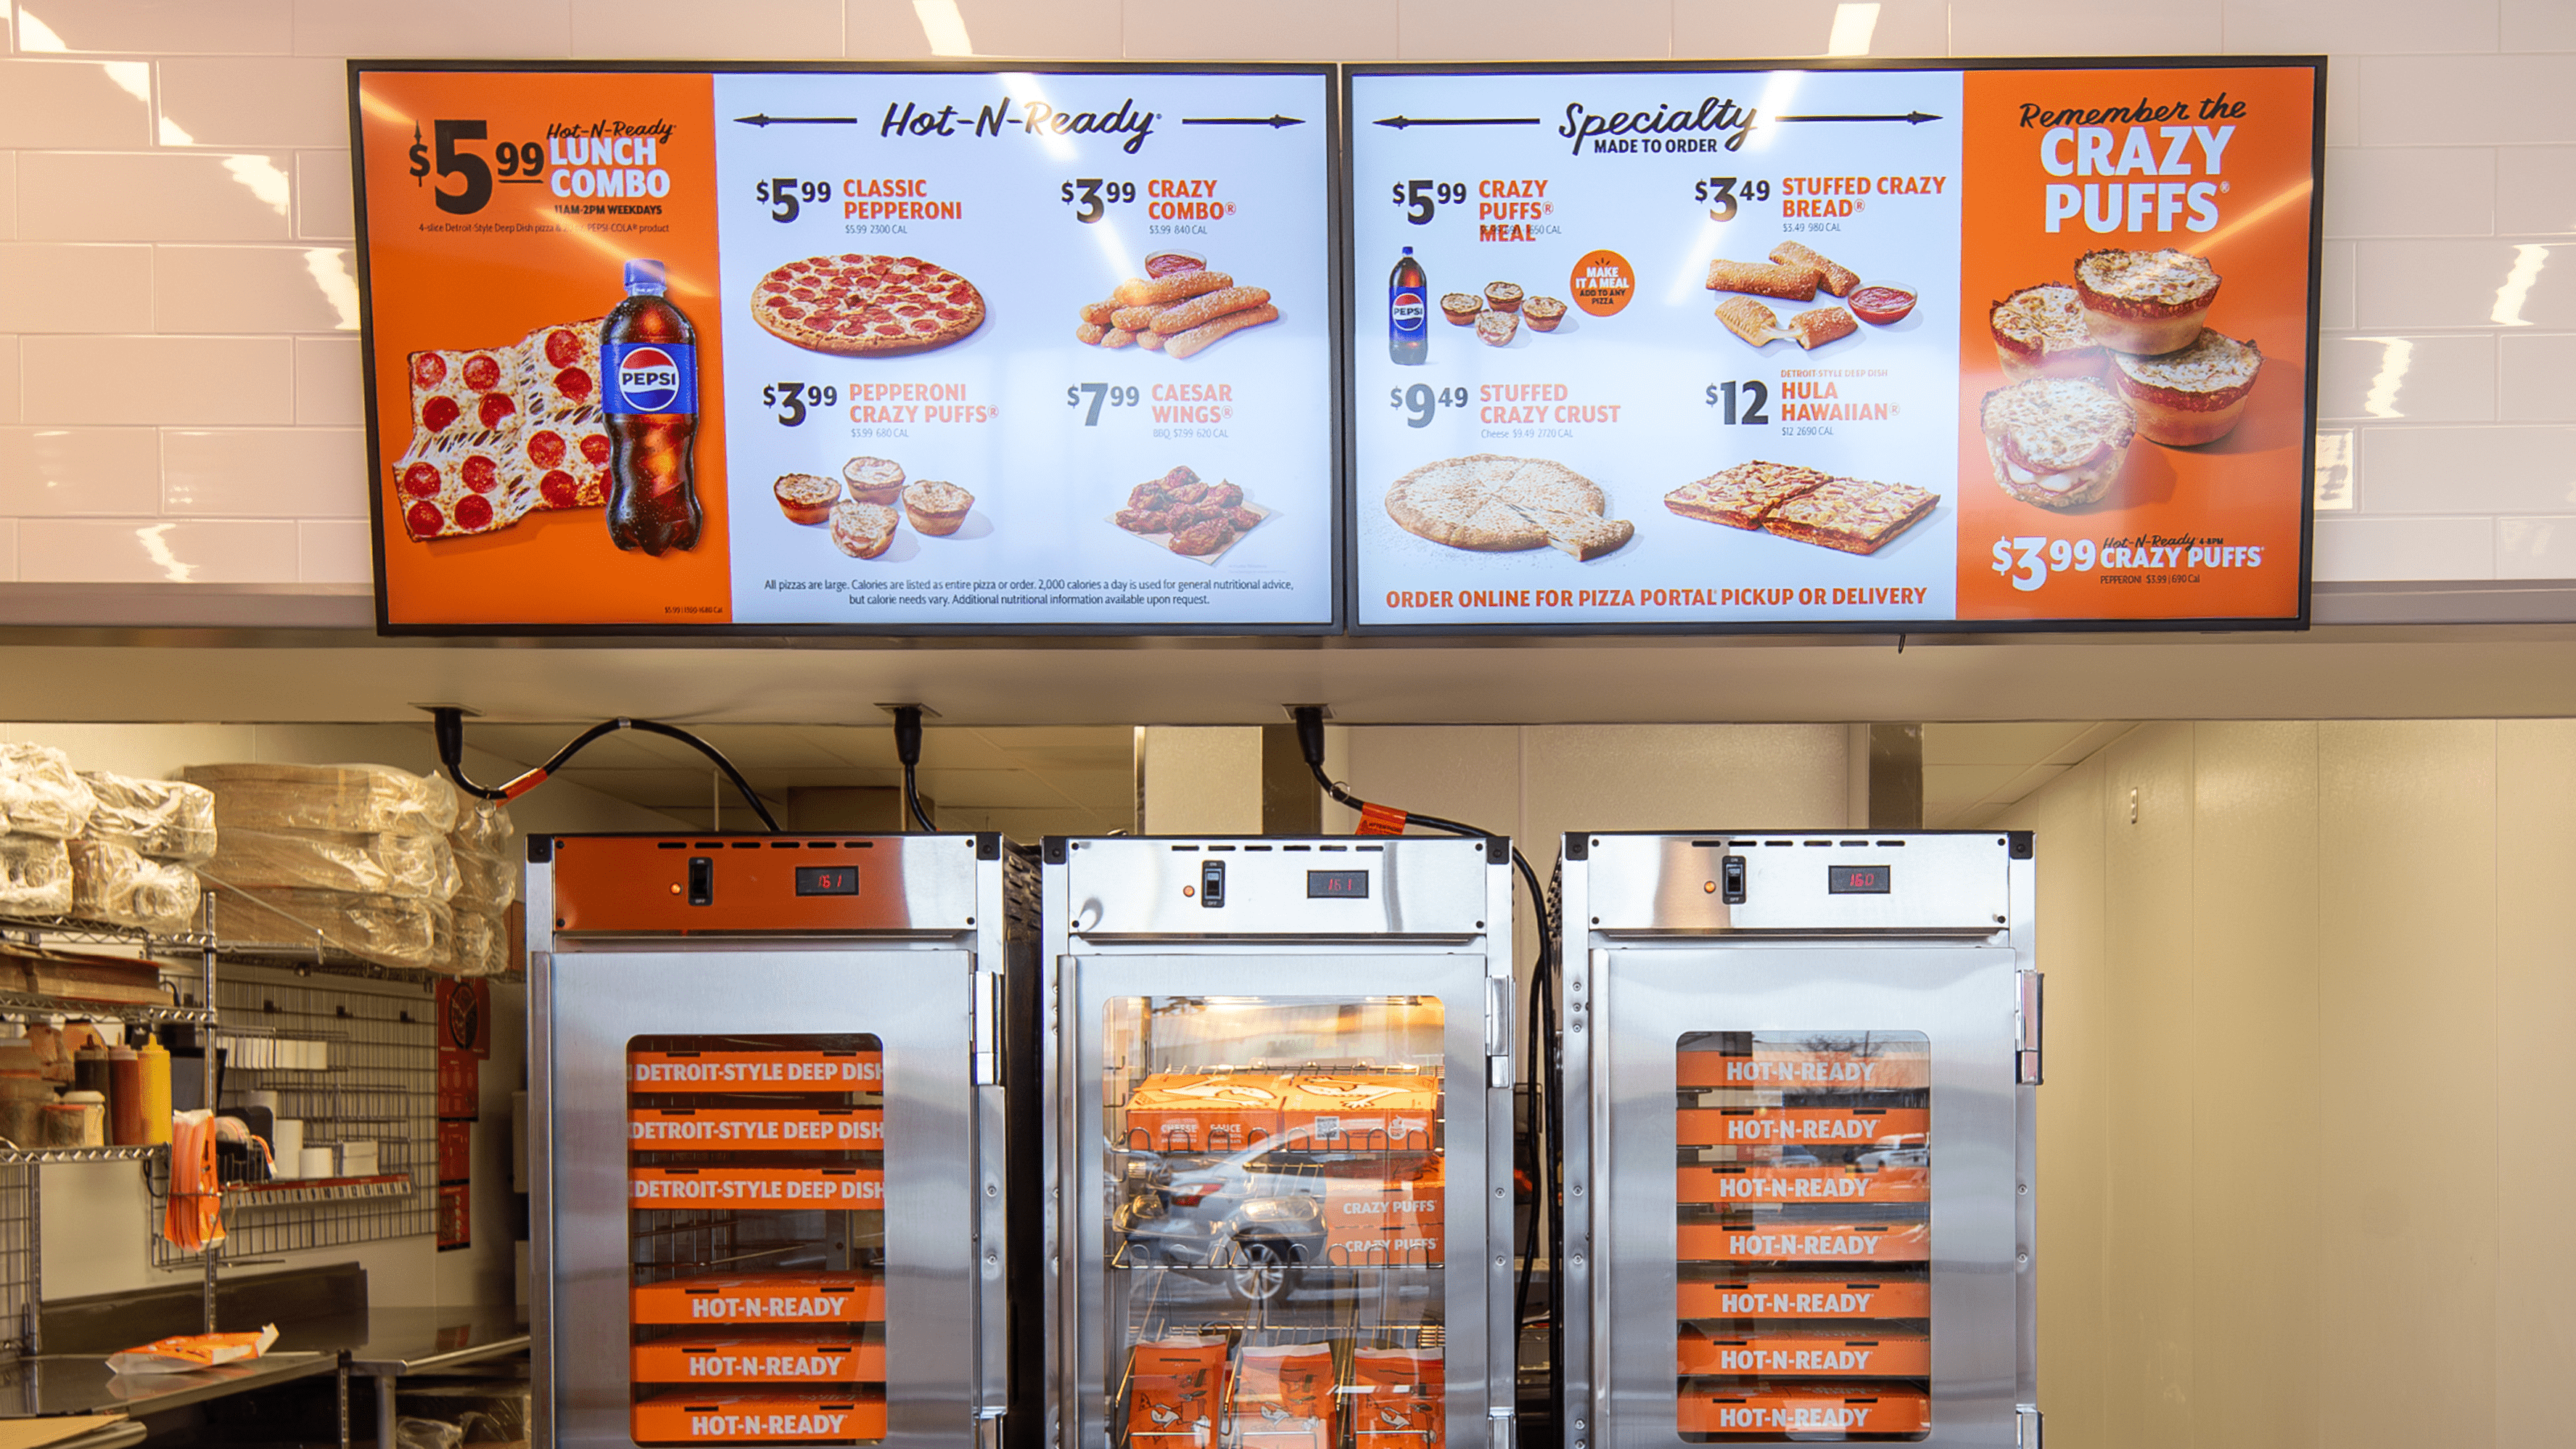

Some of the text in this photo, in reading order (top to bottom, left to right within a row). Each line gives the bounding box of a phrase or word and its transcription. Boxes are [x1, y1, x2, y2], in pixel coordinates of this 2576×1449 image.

[2020, 91, 2247, 129] Remember the
[1559, 96, 1758, 156] Specialty
[549, 136, 657, 166] LUNCH
[1594, 139, 1718, 153] MADE TO ORDER
[2040, 125, 2236, 177] CRAZY
[551, 168, 670, 198] COMBO
[843, 179, 927, 197] CLASSIC
[1148, 180, 1217, 198] CRAZY
[1479, 180, 1548, 198] CRAZY
[1782, 176, 1946, 195] STUFFED CRAZY
[554, 205, 662, 215] 11AM-2PM WEEKDAYS
[844, 202, 962, 219] PEPPERONI
[639, 223, 670, 234] product
[844, 224, 908, 234] $5.99 2300 CAL
[1150, 224, 1208, 235] $3.99 840 CAL
[1479, 223, 1536, 242] MEAL
[1546, 224, 1562, 234] CAL
[1782, 222, 1805, 232] $3.49
[1825, 223, 1841, 232] CAL
[1587, 266, 1619, 278] MAKE
[1576, 277, 1630, 289] IT A MEAL
[1394, 307, 1423, 316] PEPSI
[622, 372, 676, 386] PEPSI
[849, 383, 966, 402] PEPPERONI
[1151, 383, 1233, 402] CAESAR
[1480, 384, 1568, 402] STUFFED
[1782, 381, 1838, 400] HULA
[1705, 380, 1769, 426] $12
[849, 405, 919, 423] CRAZY
[1480, 405, 1621, 424] CRAZY CRUST
[851, 428, 909, 438] $3.99 680 CAL
[1173, 428, 1229, 438] $7.99 620 CAL
[1481, 429, 1509, 438] Cheese
[1513, 428, 1534, 439] $9.49
[1557, 429, 1573, 438] CAL
[1782, 426, 1834, 436] $12 2690 CAL
[2100, 546, 2182, 569] CRAZY
[779, 579, 806, 592] pizzas
[852, 579, 888, 590] Calories
[907, 579, 931, 590] listed
[945, 580, 972, 590] entire
[974, 580, 996, 592] pizza
[1038, 579, 1065, 591] 2,000
[1067, 579, 1102, 590] calories
[1111, 579, 1127, 592] day
[1139, 579, 1161, 590] used
[1164, 579, 1176, 590] for
[1178, 579, 1211, 592] general
[1214, 579, 1260, 590] nutritional
[2099, 574, 2200, 585] PEPPERONI Cal
[849, 594, 865, 605] but
[867, 594, 897, 605] calorie
[899, 594, 926, 605] needs
[952, 594, 999, 605] Additional
[1001, 594, 1048, 605] nutritional
[1050, 594, 1103, 605] information
[1105, 594, 1145, 605] available
[1146, 596, 1171, 607] upon
[1386, 591, 1454, 608] ORDER
[1458, 590, 1531, 608] ONLINE
[1536, 590, 1573, 607] FOR
[1579, 590, 1636, 607] PIZZA
[1721, 588, 1794, 606] PICKUP
[1798, 588, 1827, 605] OR
[1832, 587, 1927, 605] DELIVERY
[636, 1063, 783, 1081] DETROIT-STYLE
[789, 1063, 838, 1081] DEEP
[633, 1122, 884, 1139] DETROIT-STYLE DEEP DISH
[1210, 1123, 1242, 1134] SAUCE
[635, 1181, 782, 1198] DETROIT-STYLE
[787, 1181, 837, 1198] DEEP
[1343, 1202, 1389, 1215] CRAZY
[1346, 1239, 1389, 1252] CRAZY
